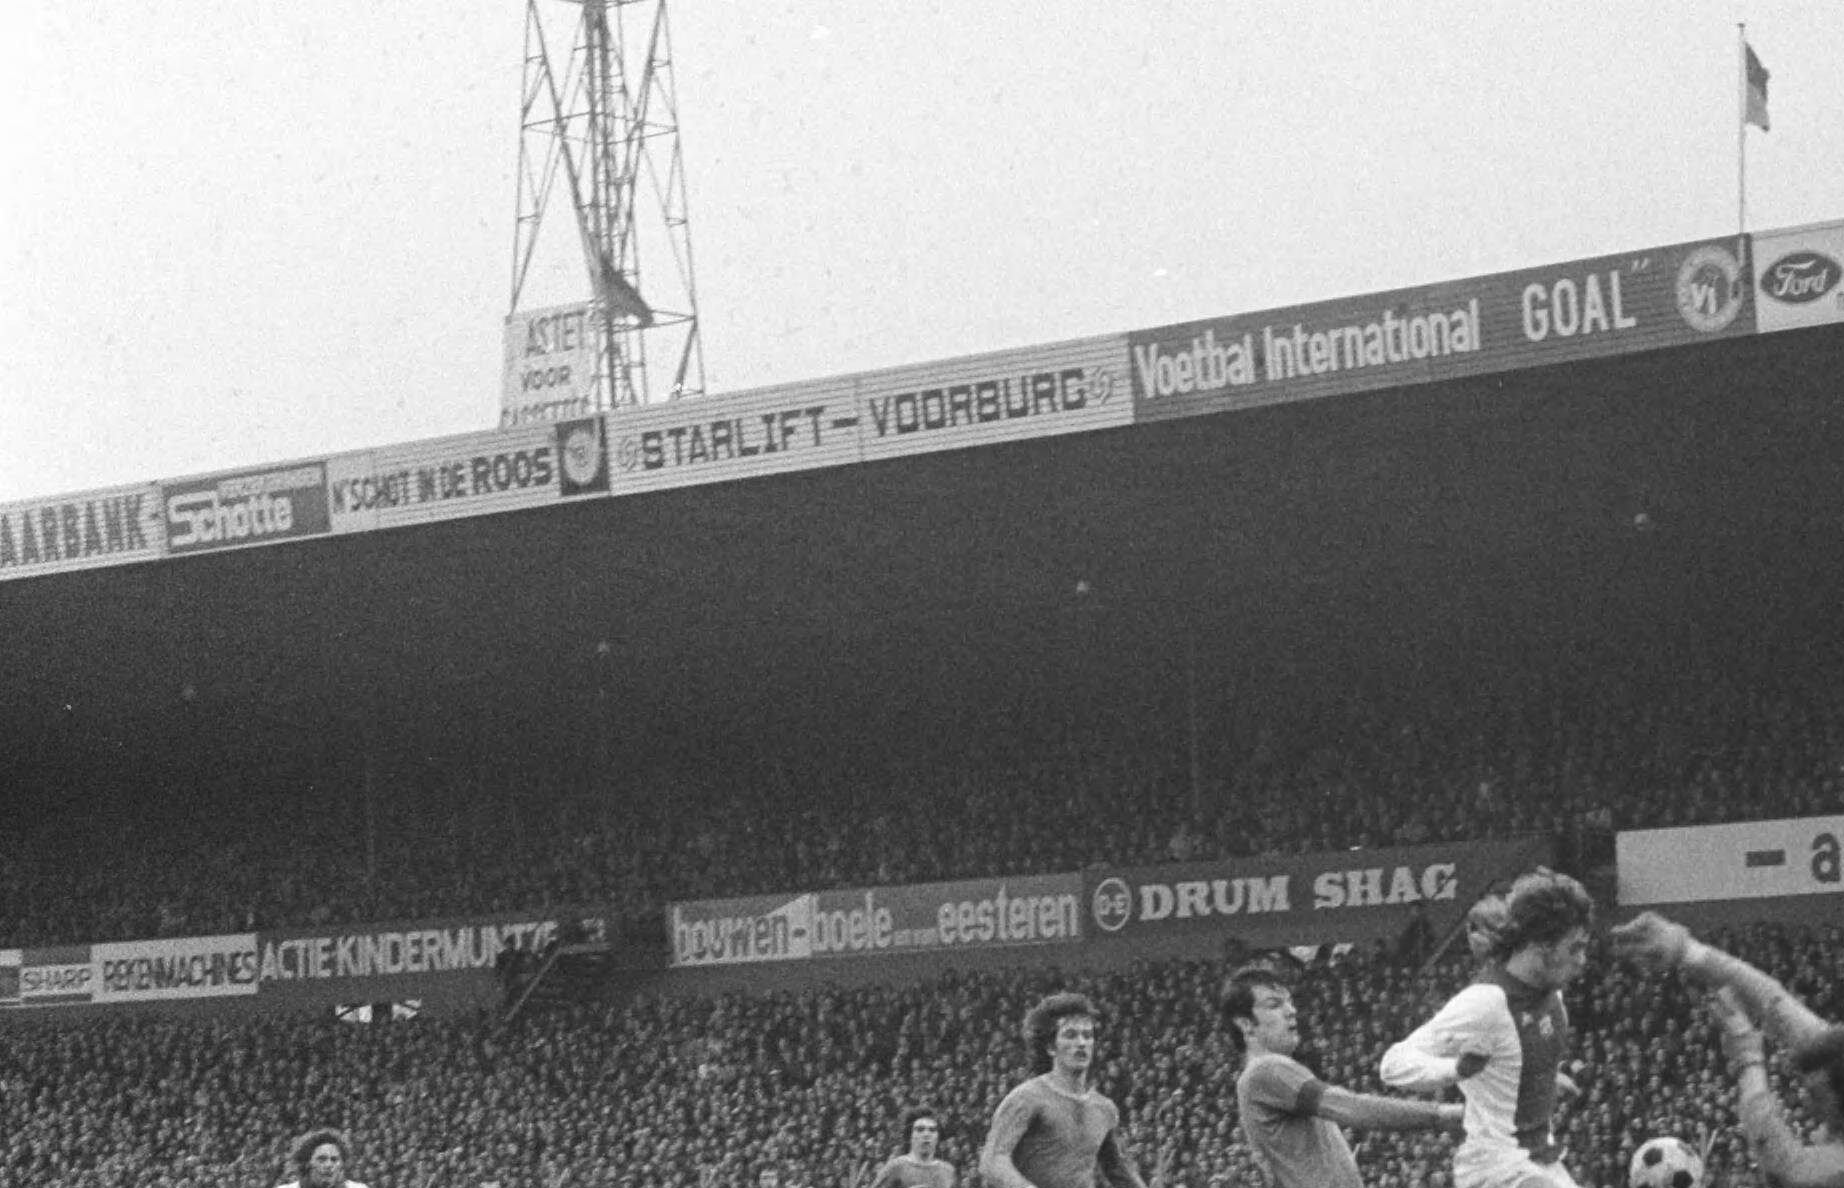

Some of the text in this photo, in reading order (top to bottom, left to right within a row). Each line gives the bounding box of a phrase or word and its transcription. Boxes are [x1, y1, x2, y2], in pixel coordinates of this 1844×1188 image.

[1773, 259, 1827, 297] Ford
[1134, 327, 1255, 399] Voetbal
[1265, 300, 1480, 380] International
[473, 447, 551, 495] ROOS
[938, 885, 1078, 944] eesteren
[1140, 863, 1458, 921] DRUM SHAG
